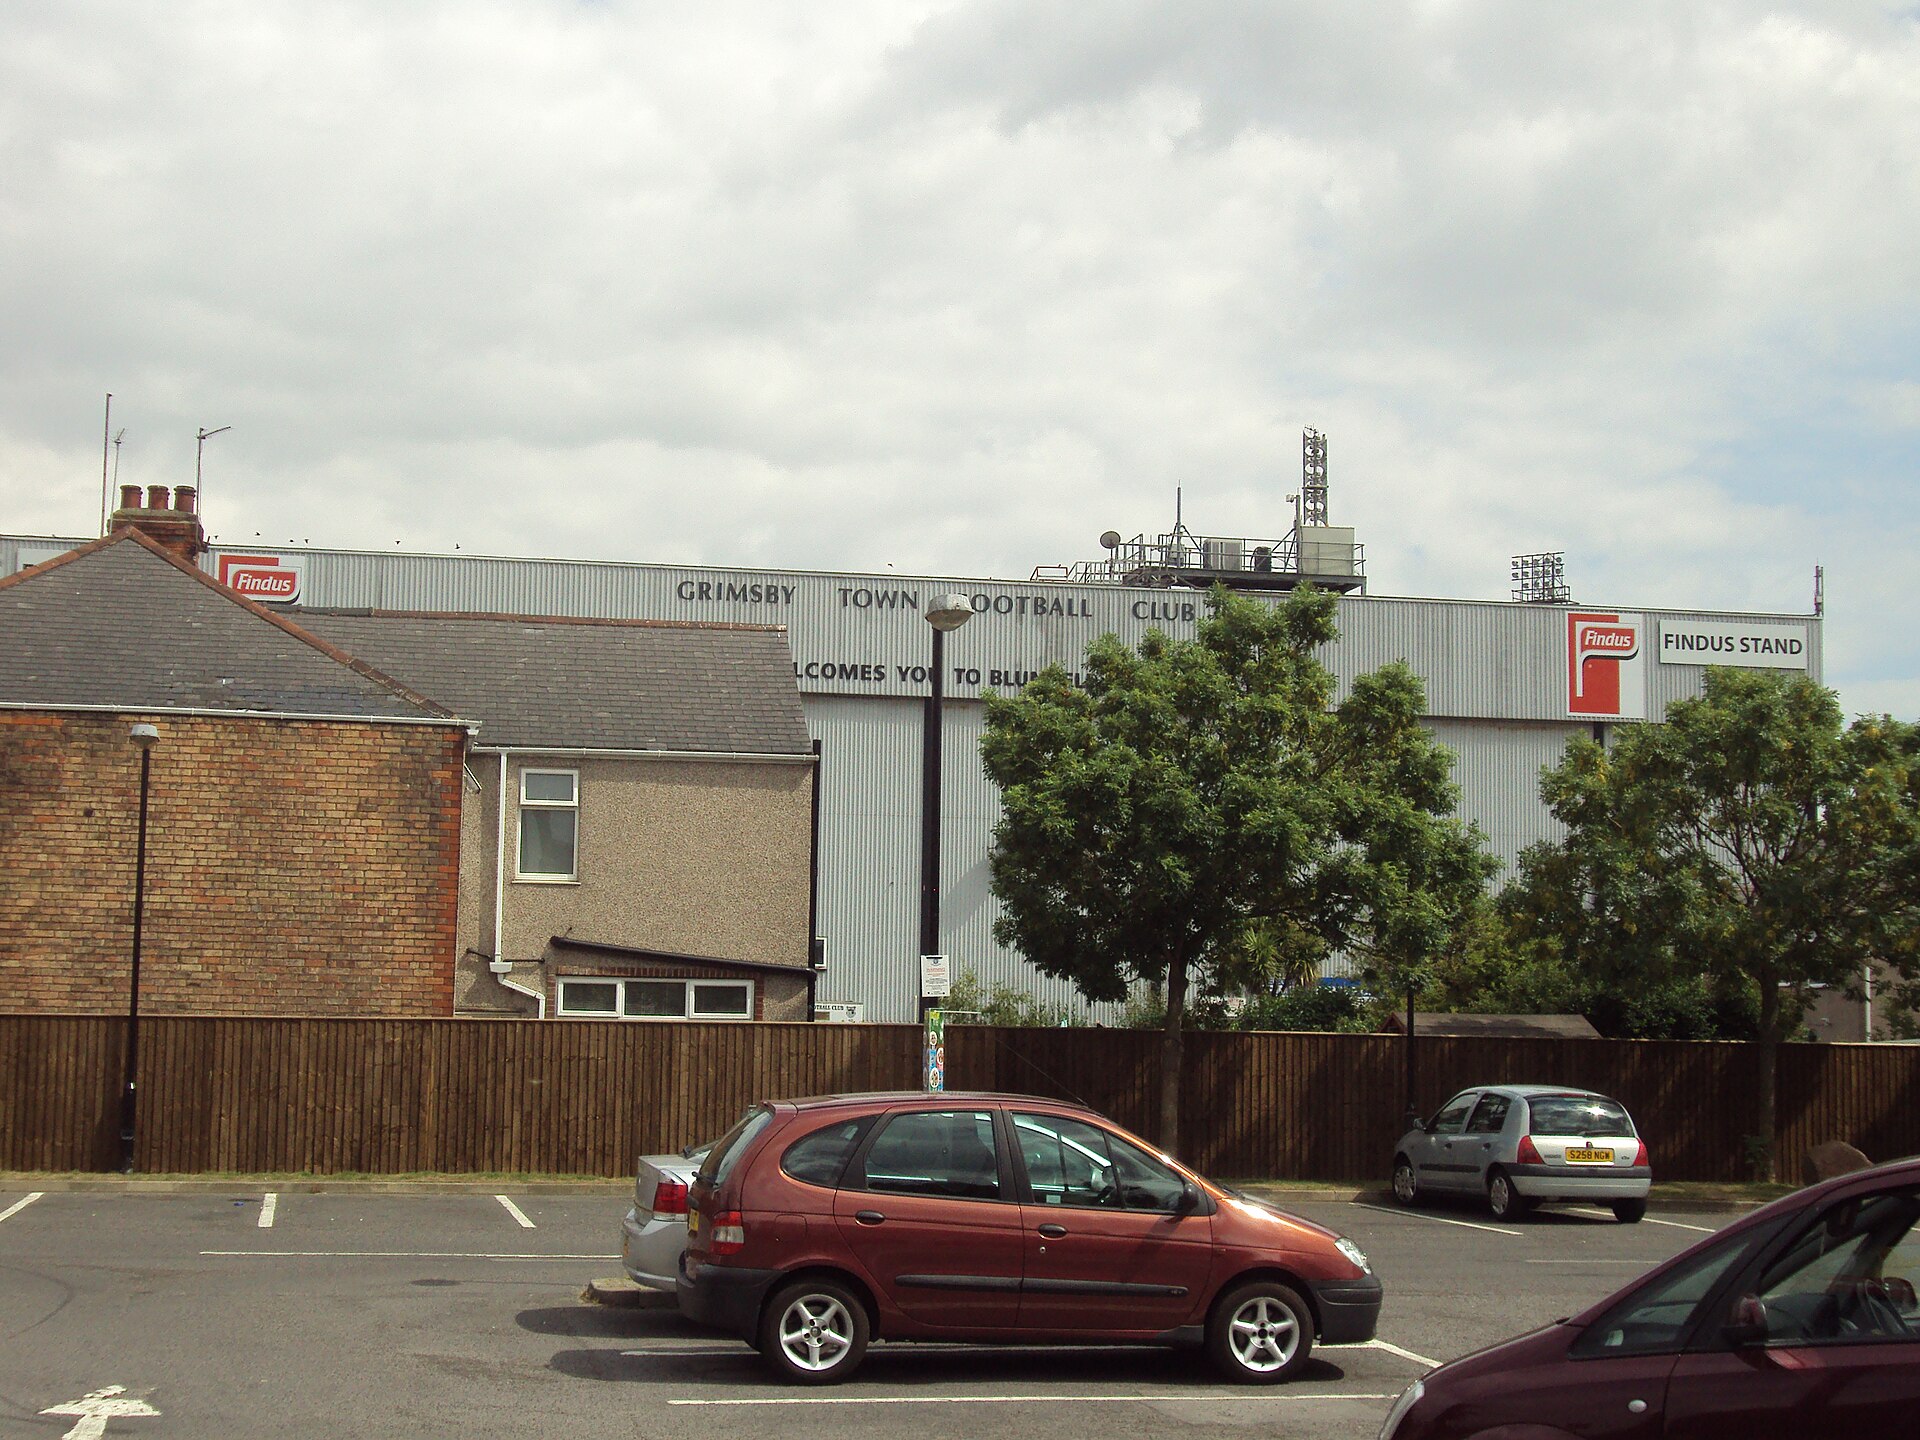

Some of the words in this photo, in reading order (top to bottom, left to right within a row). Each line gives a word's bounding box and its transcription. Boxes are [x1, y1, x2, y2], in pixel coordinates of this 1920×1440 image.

[237, 573, 291, 592] Findus
[677, 580, 796, 605] GRIMSBY
[838, 587, 919, 609] TOWN
[957, 592, 1092, 618] OOTBALL
[1132, 600, 1195, 622] CLUB
[1584, 629, 1631, 648] Findus
[1664, 633, 1735, 653] FINDUS
[1740, 636, 1803, 655] STAND
[793, 661, 885, 682] LCOMES
[954, 668, 981, 686] TO
[1570, 1150, 1592, 1160] S258
[1594, 1151, 1610, 1160] NGW
